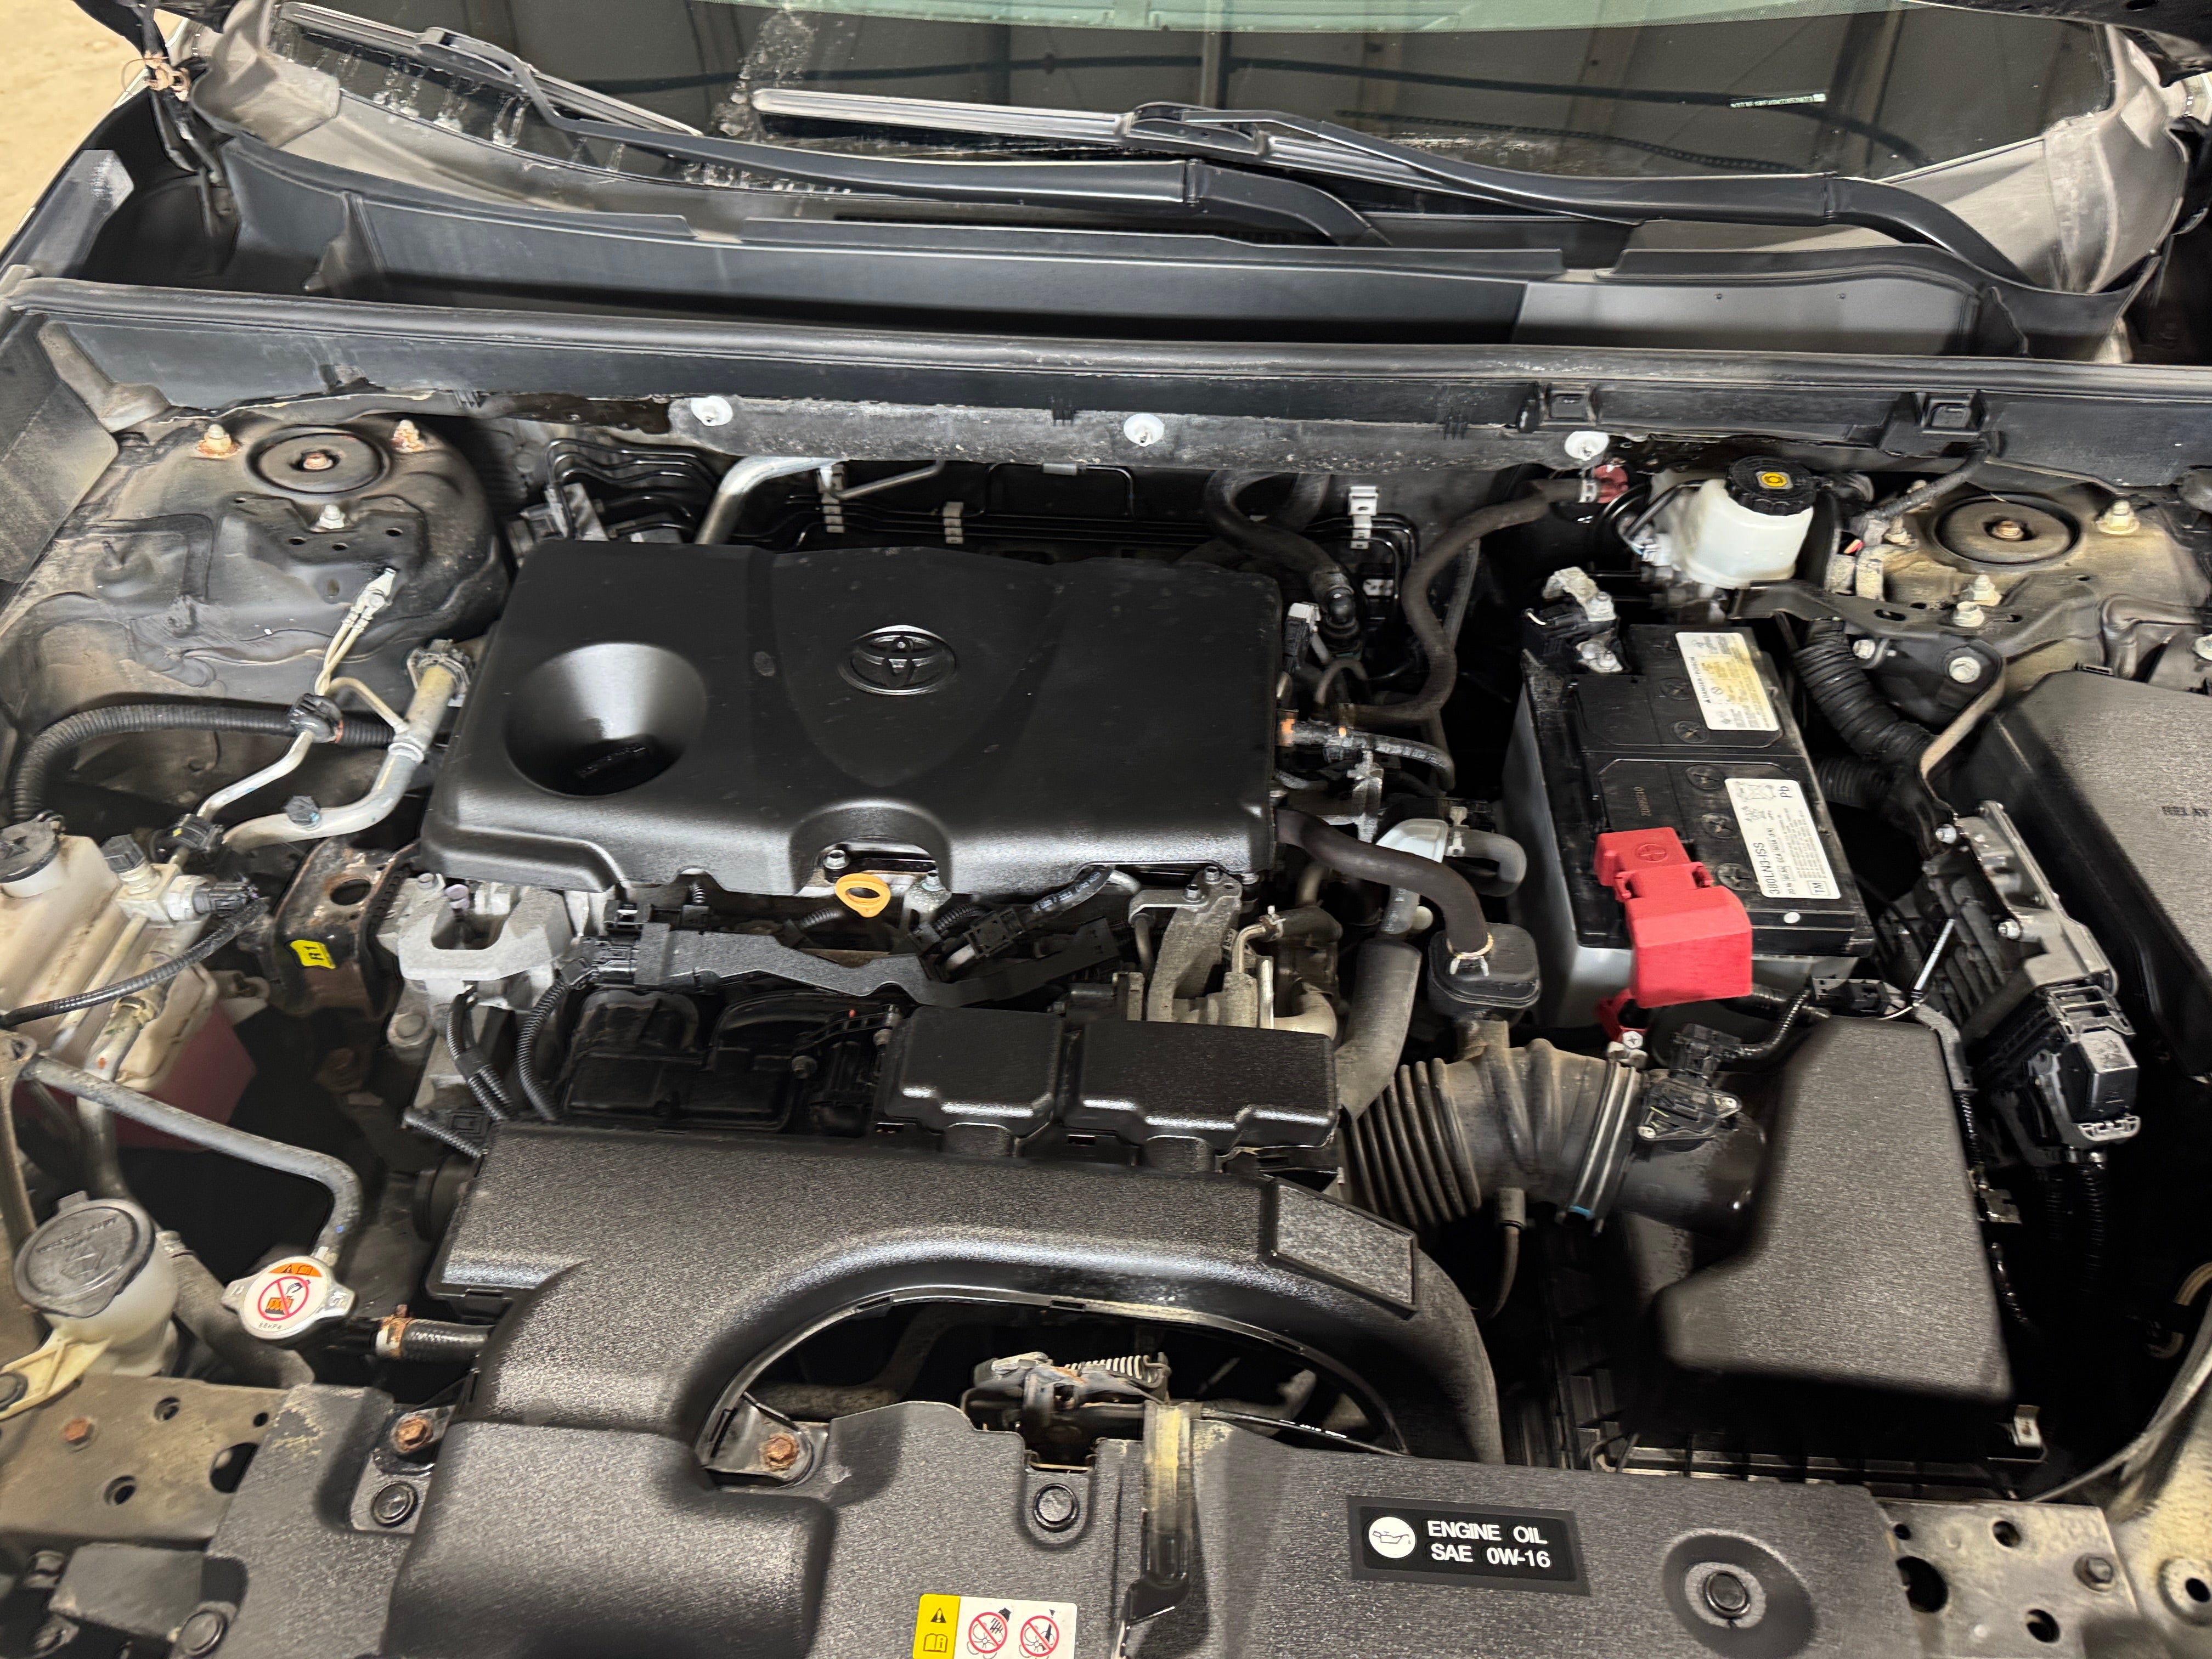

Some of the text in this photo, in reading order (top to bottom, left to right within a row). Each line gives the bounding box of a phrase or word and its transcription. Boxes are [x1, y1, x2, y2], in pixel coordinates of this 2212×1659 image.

[1778, 786, 1793, 798] Pb
[1812, 882, 1826, 893] TM
[1427, 1520, 1548, 1544] ENGINE OIL
[1431, 1543, 1551, 1568] SAE 0W-16
